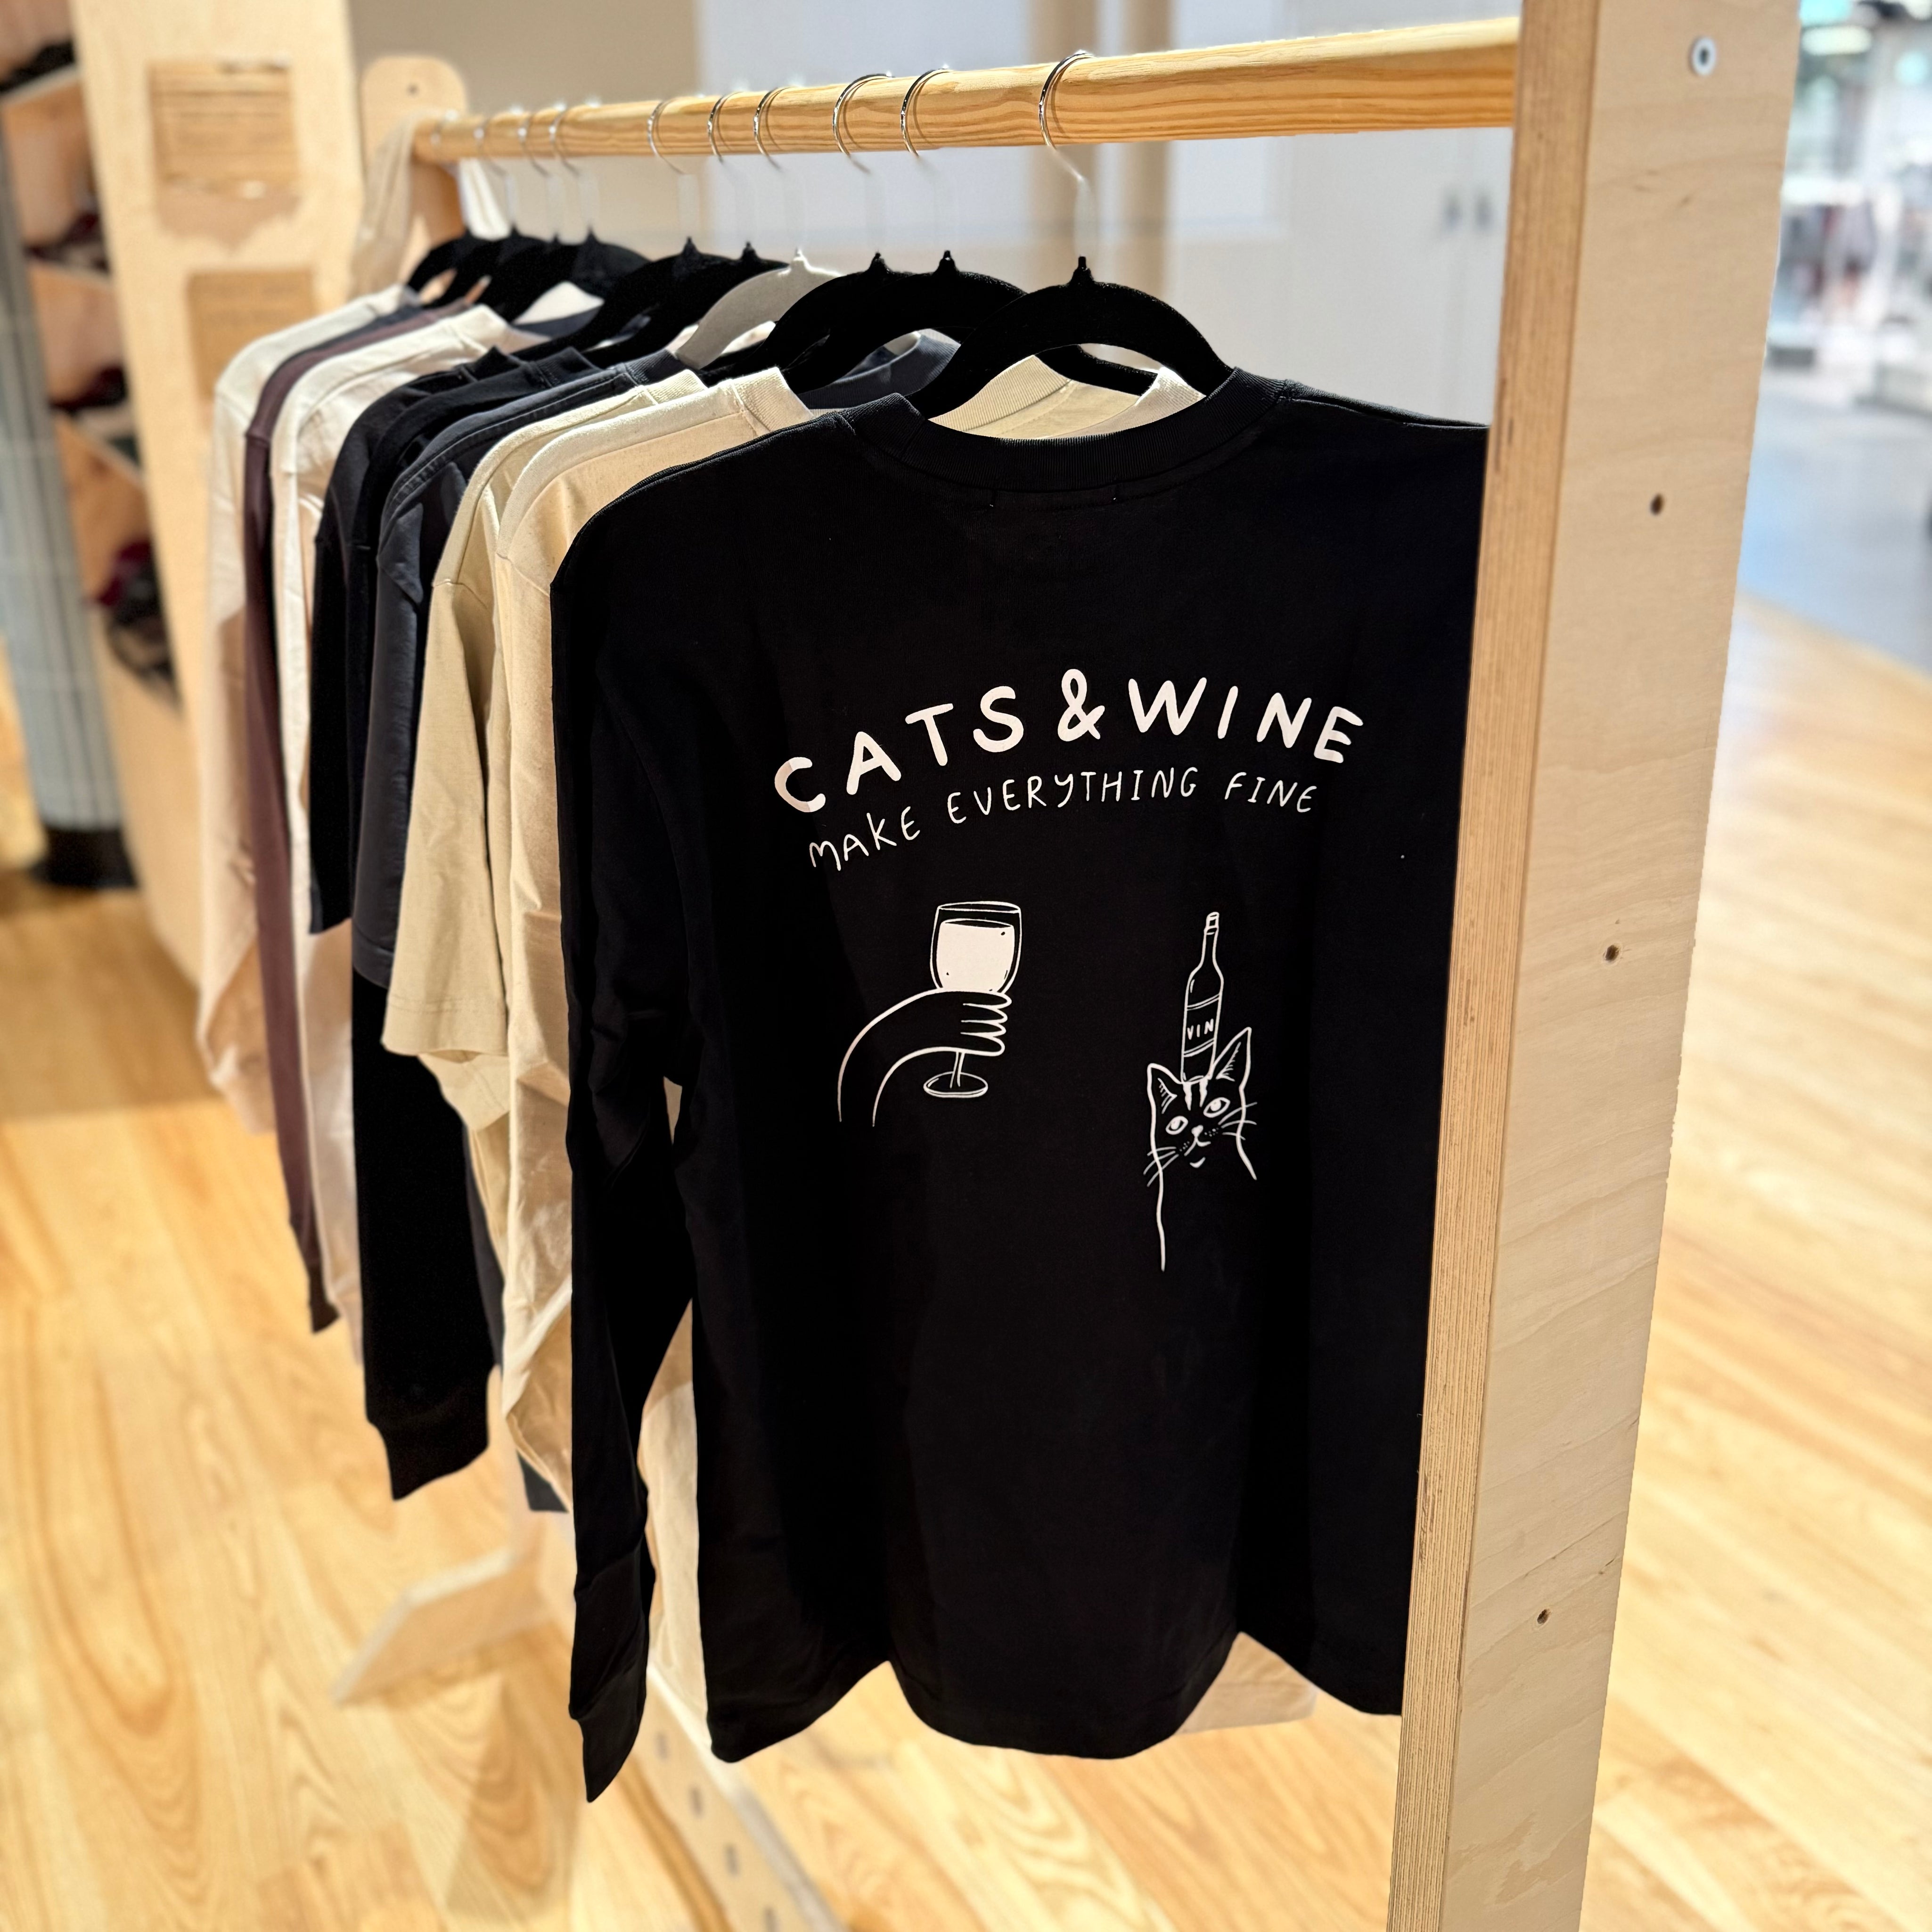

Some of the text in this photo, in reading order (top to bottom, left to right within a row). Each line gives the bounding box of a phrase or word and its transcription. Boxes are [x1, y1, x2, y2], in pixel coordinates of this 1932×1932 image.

[774, 669, 1364, 813] CATS & WINE
[809, 767, 1317, 871] MAKE EVERYTHING FINE
[1187, 1018, 1214, 1040] VIN
